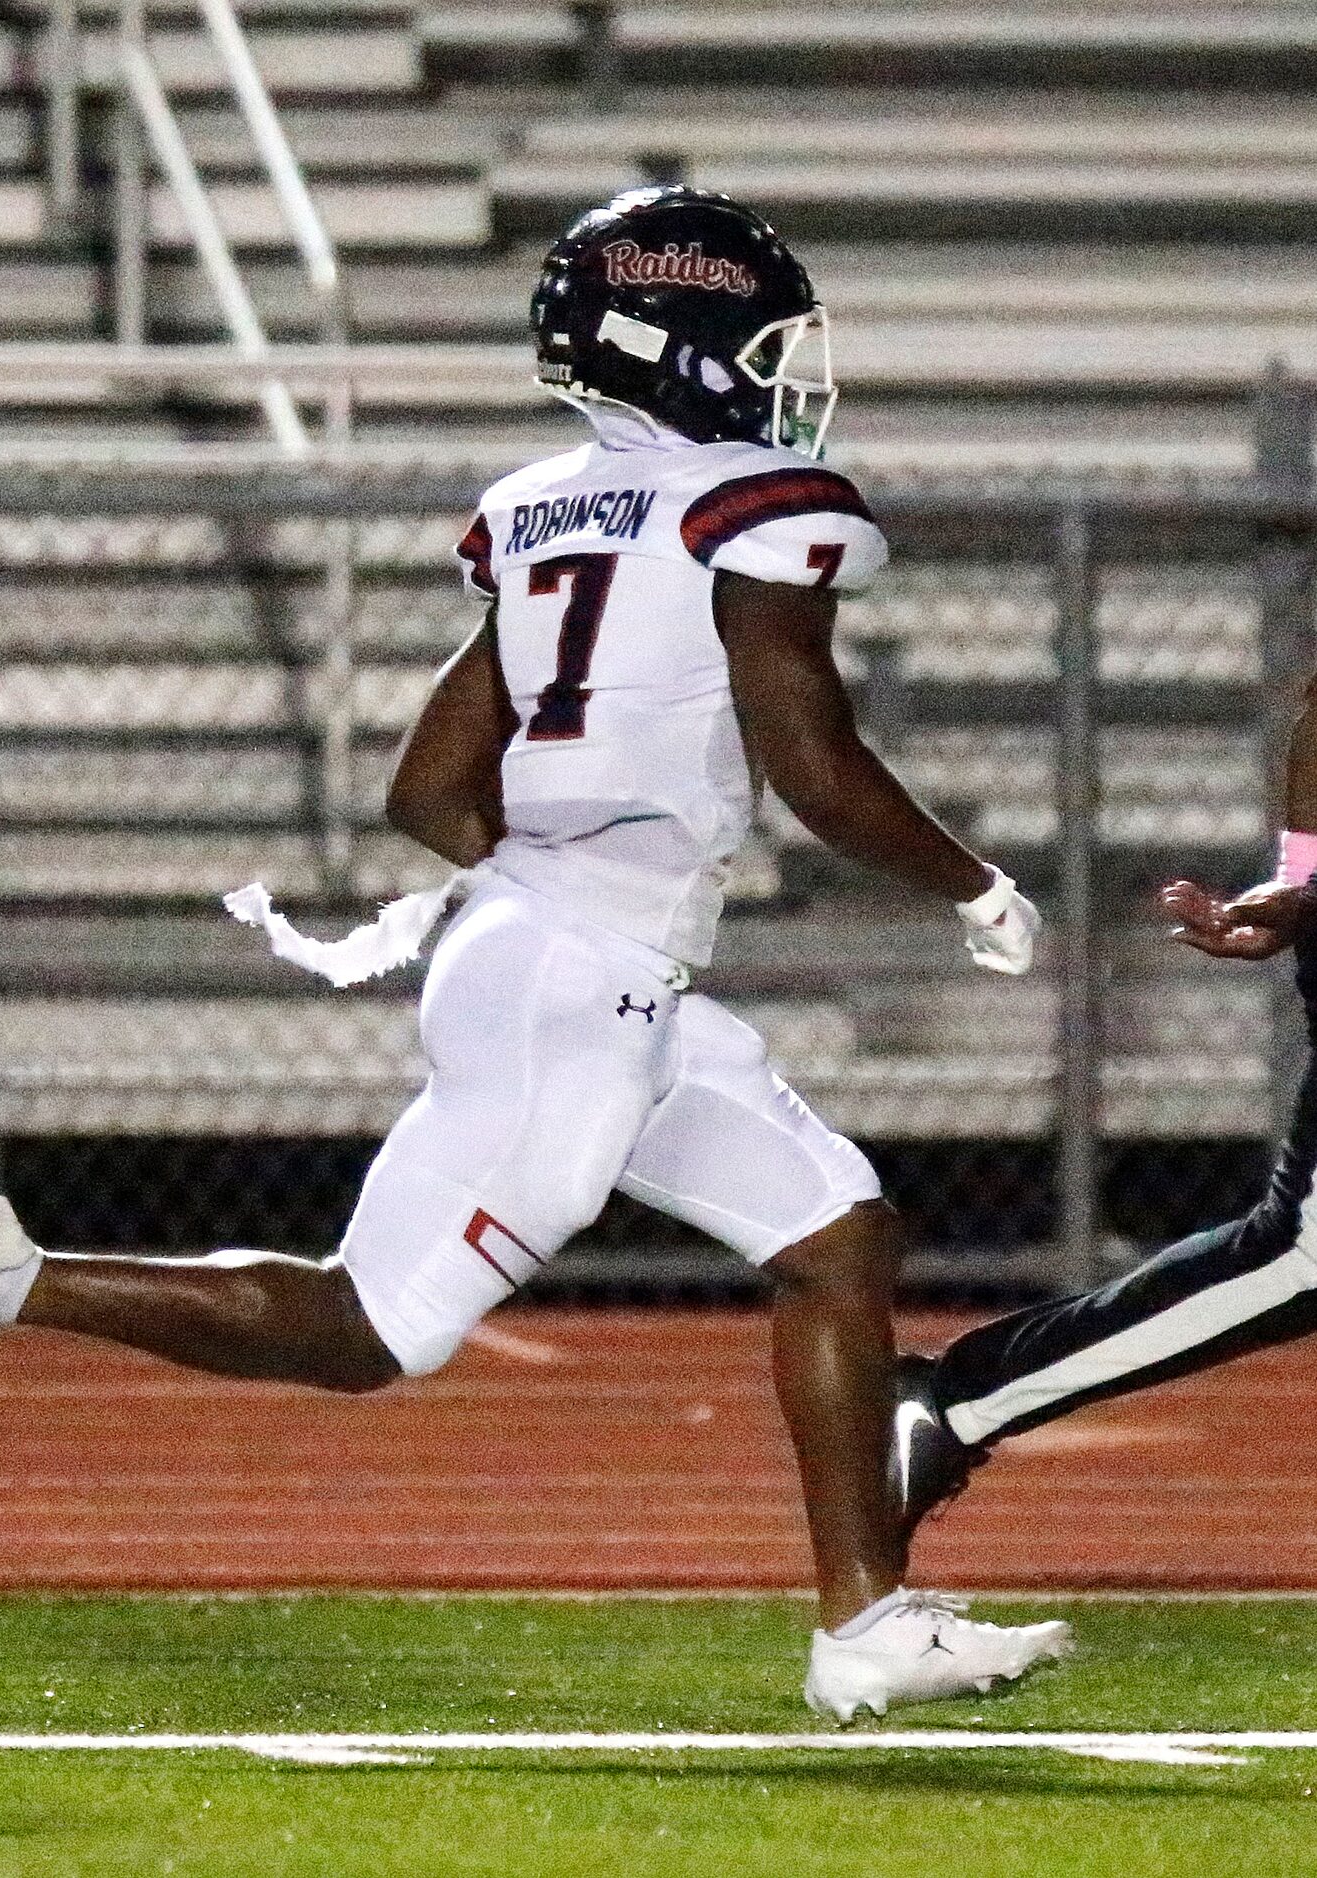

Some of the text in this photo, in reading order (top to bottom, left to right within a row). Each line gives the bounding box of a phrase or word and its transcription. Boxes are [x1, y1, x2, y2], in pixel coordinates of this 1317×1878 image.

[602, 239, 756, 297] Raiders
[505, 490, 657, 556] ROBINSON
[806, 544, 847, 589] 7
[526, 552, 620, 742] 7
